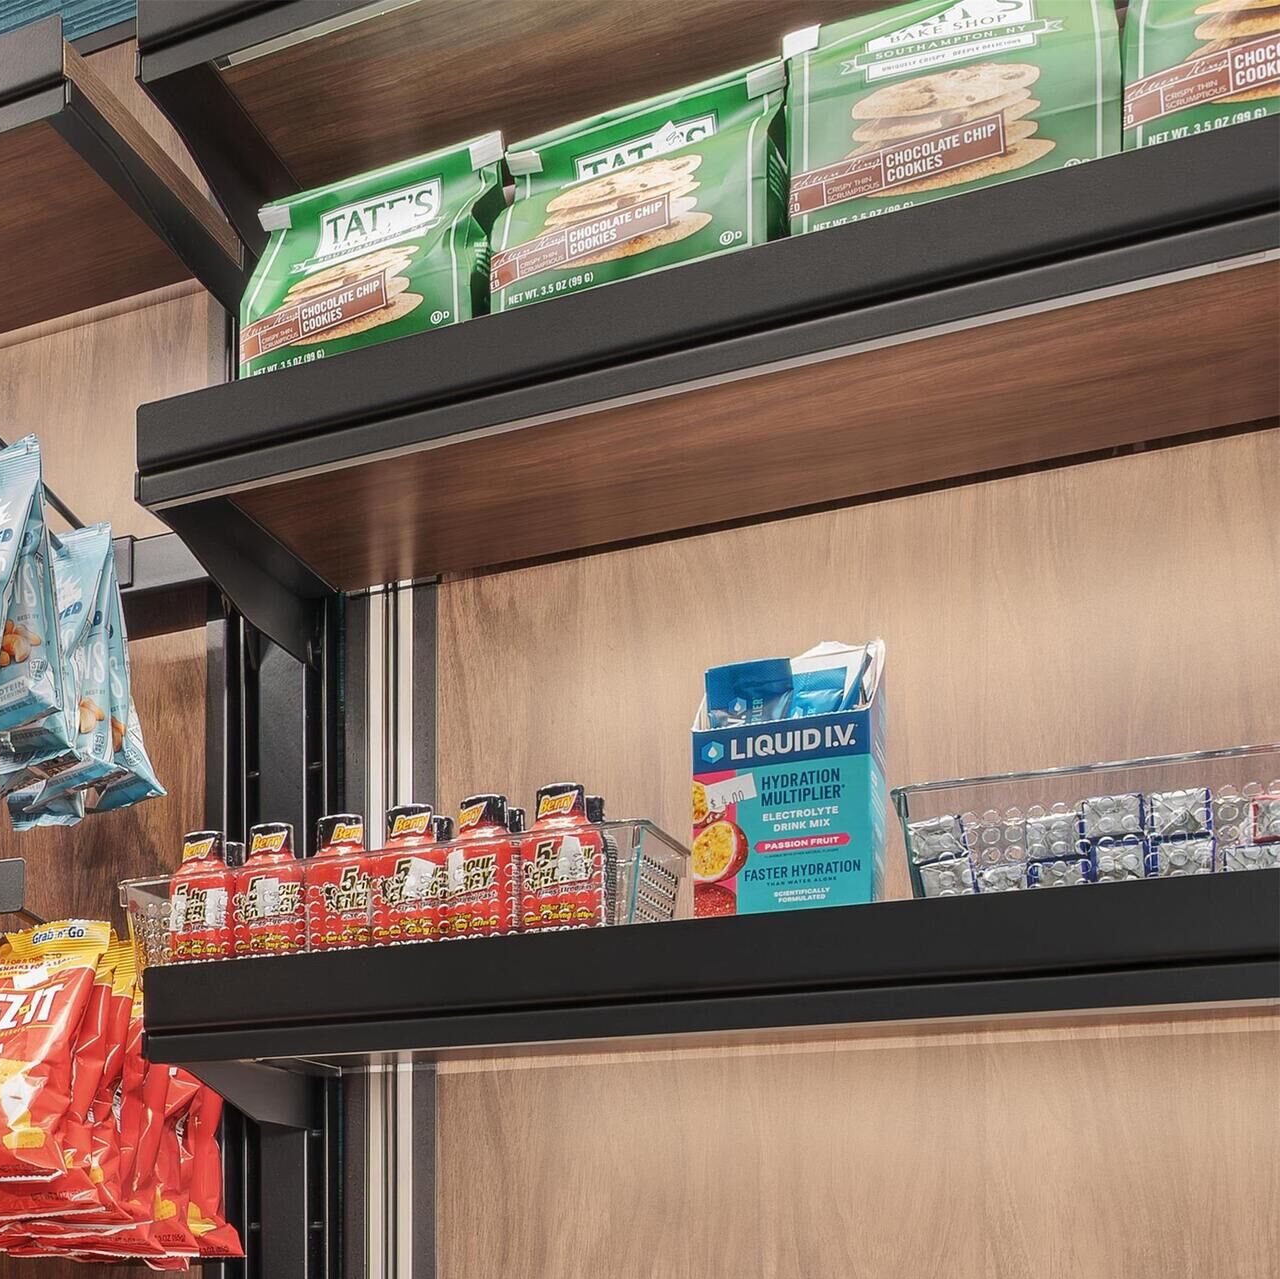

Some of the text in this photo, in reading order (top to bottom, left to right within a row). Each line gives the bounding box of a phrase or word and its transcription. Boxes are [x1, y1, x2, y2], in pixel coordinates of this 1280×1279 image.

[953, 14, 1008, 33] SHOP
[1005, 25, 1026, 36] NY
[886, 124, 996, 167] CHOCOLATE CHIP
[887, 155, 943, 182] COOKIES
[827, 176, 872, 196] CRISPY THIN
[827, 181, 880, 202] SCRUMPTIOUS
[569, 202, 663, 242] CHOCOLATE CHIP
[570, 229, 617, 254] COOKIES
[508, 272, 594, 305] NET WT. 3.5 OZ (99 G)
[302, 280, 380, 320] CHOCOLATE CHIP
[302, 308, 342, 332] COOKIES
[730, 724, 856, 761] LIQUID I.V.
[761, 768, 841, 791] HYDRATION
[541, 794, 573, 814] Berry
[761, 783, 842, 807] MULTIPLIER
[396, 815, 428, 831] Berry
[762, 806, 839, 822] ELECTROLYTE
[773, 818, 831, 832] DRINK MIX
[764, 835, 840, 851] PASSION FRUIT
[744, 859, 862, 882] FASTER HYDRATION
[773, 887, 832, 898] SCIENTIFICALLY
[778, 893, 826, 904] FORMULATED
[32, 926, 85, 945] Grab Go
